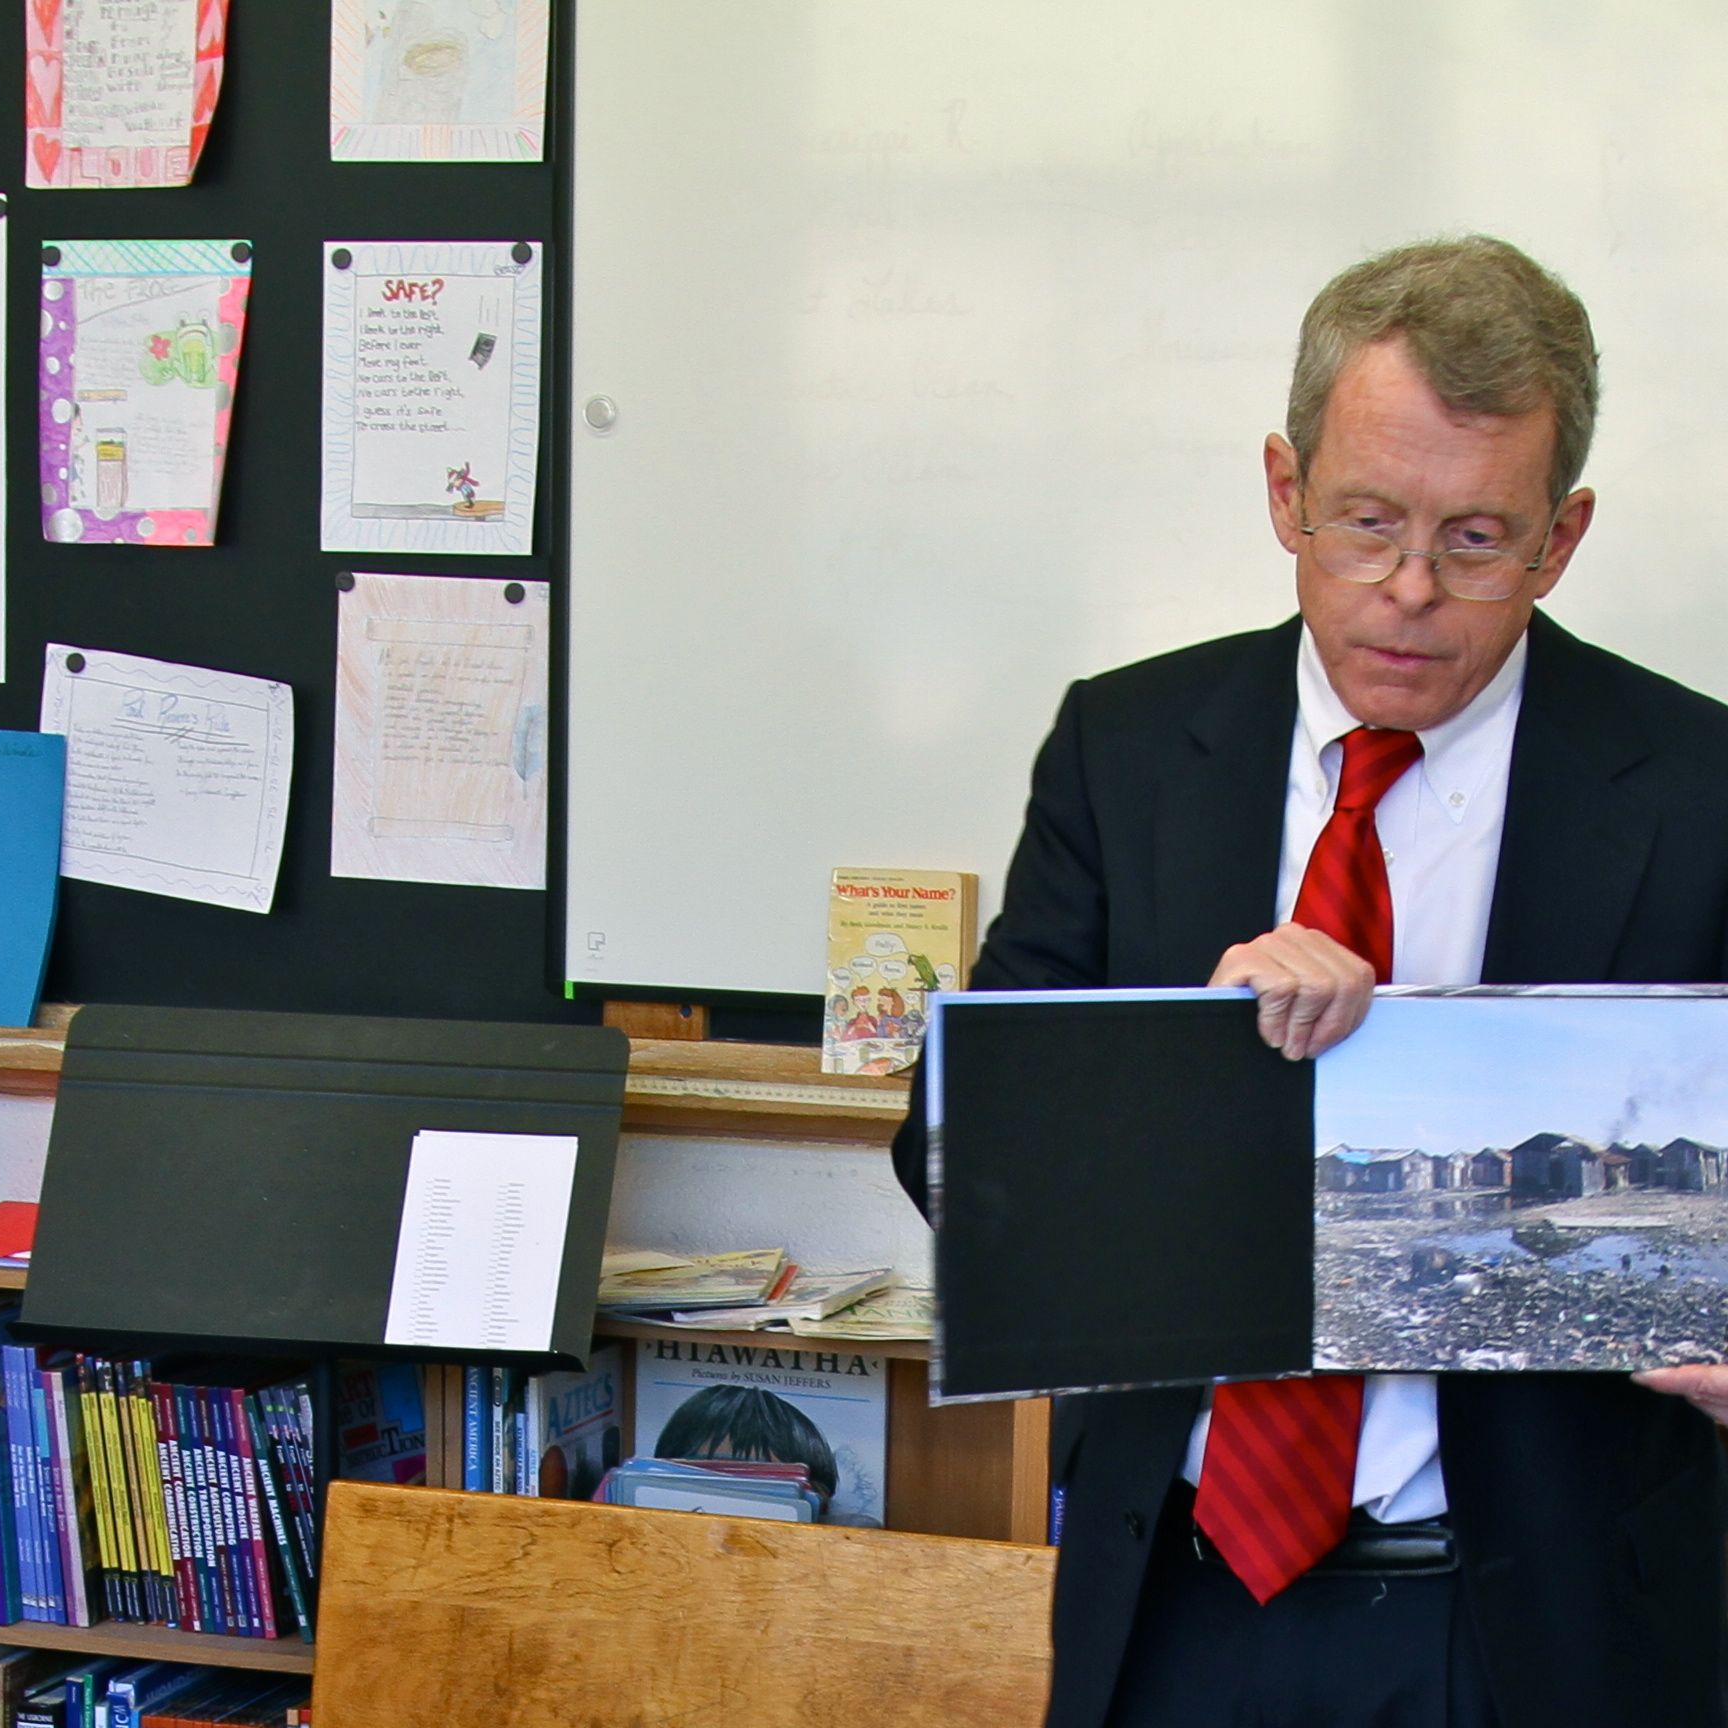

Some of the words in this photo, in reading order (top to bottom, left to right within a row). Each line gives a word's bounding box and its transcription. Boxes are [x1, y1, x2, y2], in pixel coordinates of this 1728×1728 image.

[381, 278, 444, 306] SAFE?
[836, 885, 879, 898] What's
[882, 886, 911, 899] Your
[913, 887, 956, 901] Name?
[654, 1340, 870, 1376] HIAWATHA
[468, 1367, 480, 1418] ANCIENT
[691, 1368, 728, 1379] Pictures
[731, 1371, 741, 1382] by
[743, 1372, 781, 1385] SUSAN
[784, 1375, 832, 1389] JEFFERS
[548, 1373, 614, 1437] AZTECS
[158, 1442, 171, 1480] ANCIENT
[169, 1440, 182, 1478] ANCIENT
[203, 1445, 217, 1483] ANCIENT
[468, 1419, 479, 1470] AMERICA
[181, 1449, 195, 1487] ANCIENT
[193, 1448, 206, 1486] ANCIENT
[216, 1450, 229, 1488] ANCIENT
[229, 1455, 242, 1492] ANCIENT
[242, 1457, 255, 1495] ANCIENT
[162, 1483, 181, 1560] COMMUNICATION
[174, 1481, 192, 1557] COMMUNICATION
[209, 1486, 225, 1546] AGRICULTURE
[222, 1492, 236, 1545] COMPUTING
[235, 1496, 249, 1539] MEDICINE
[248, 1498, 261, 1541] WARFARE
[258, 1459, 276, 1497] ANCIENT
[269, 1500, 287, 1545] MACHINES
[186, 1491, 203, 1558] CONSTRUCTION
[198, 1489, 216, 1567] TRANSPORTATION
